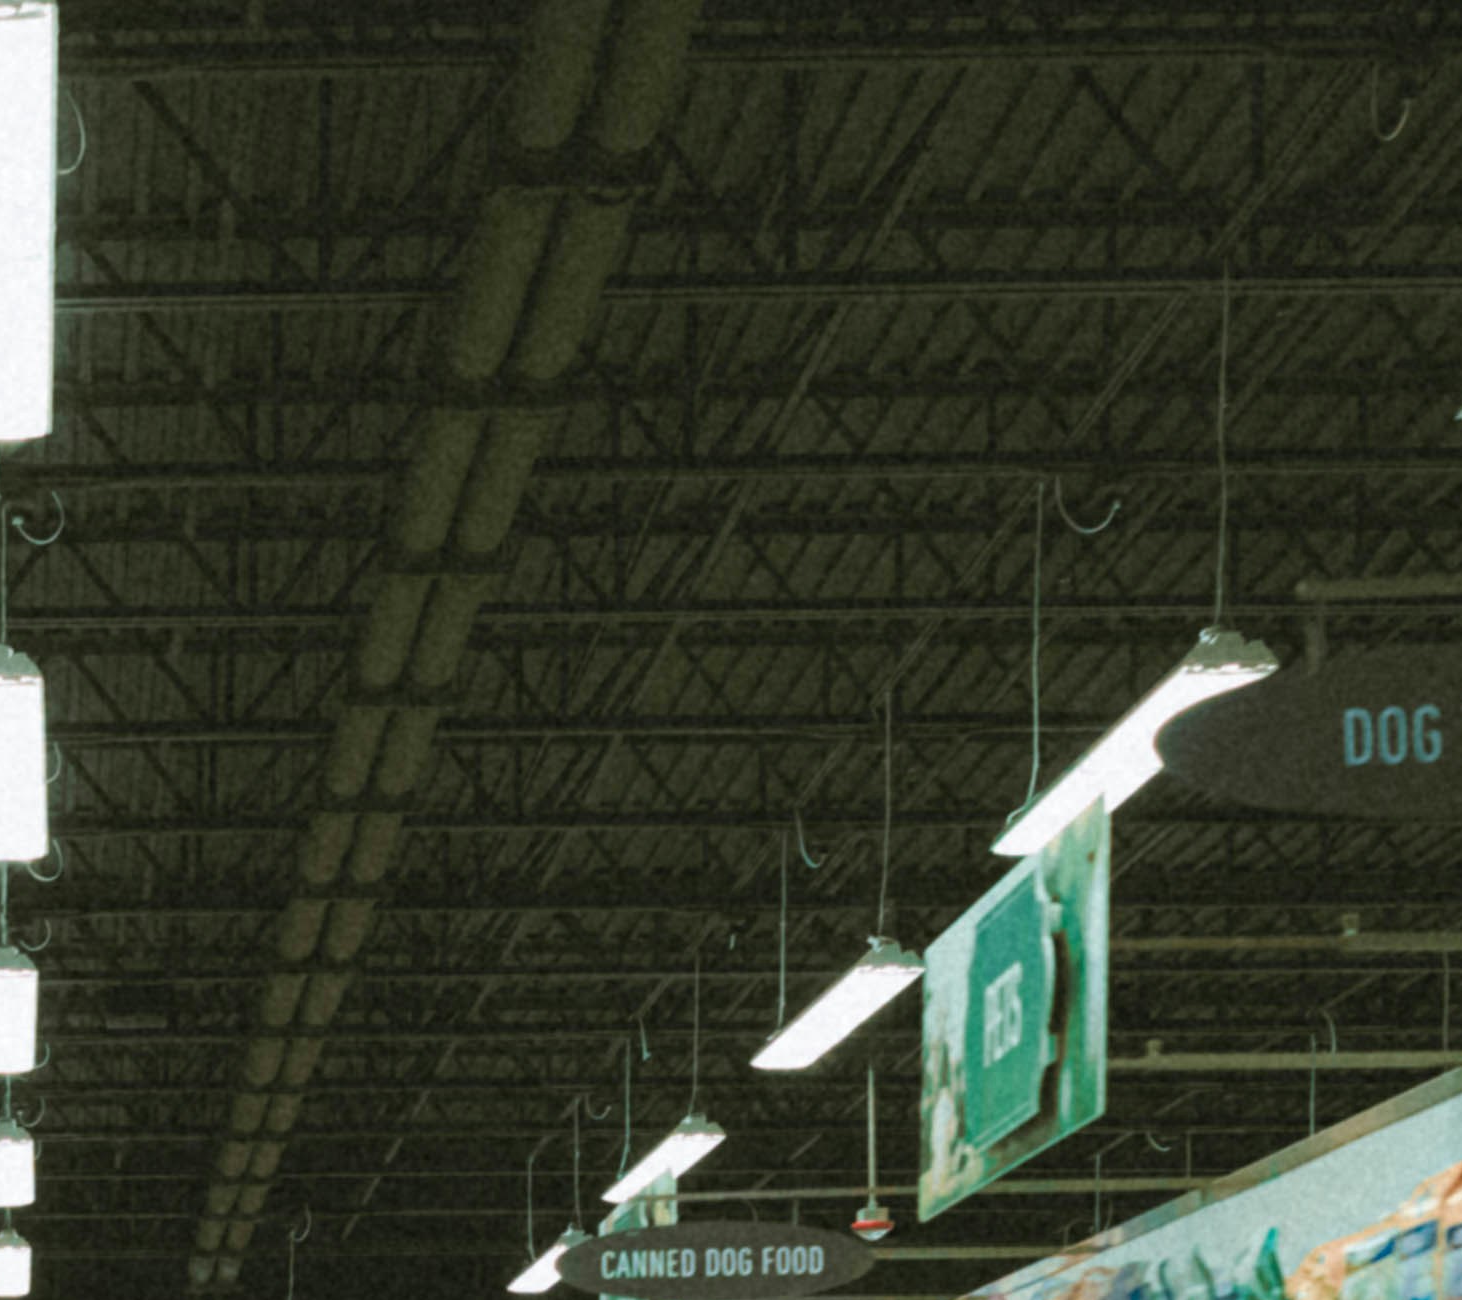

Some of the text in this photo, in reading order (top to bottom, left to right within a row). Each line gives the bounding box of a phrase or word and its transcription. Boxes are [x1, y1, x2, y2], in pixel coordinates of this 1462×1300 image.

[1343, 704, 1443, 766] DOG
[983, 961, 1023, 1068] PETS
[600, 1245, 825, 1280] CANNED DOG FOOD
